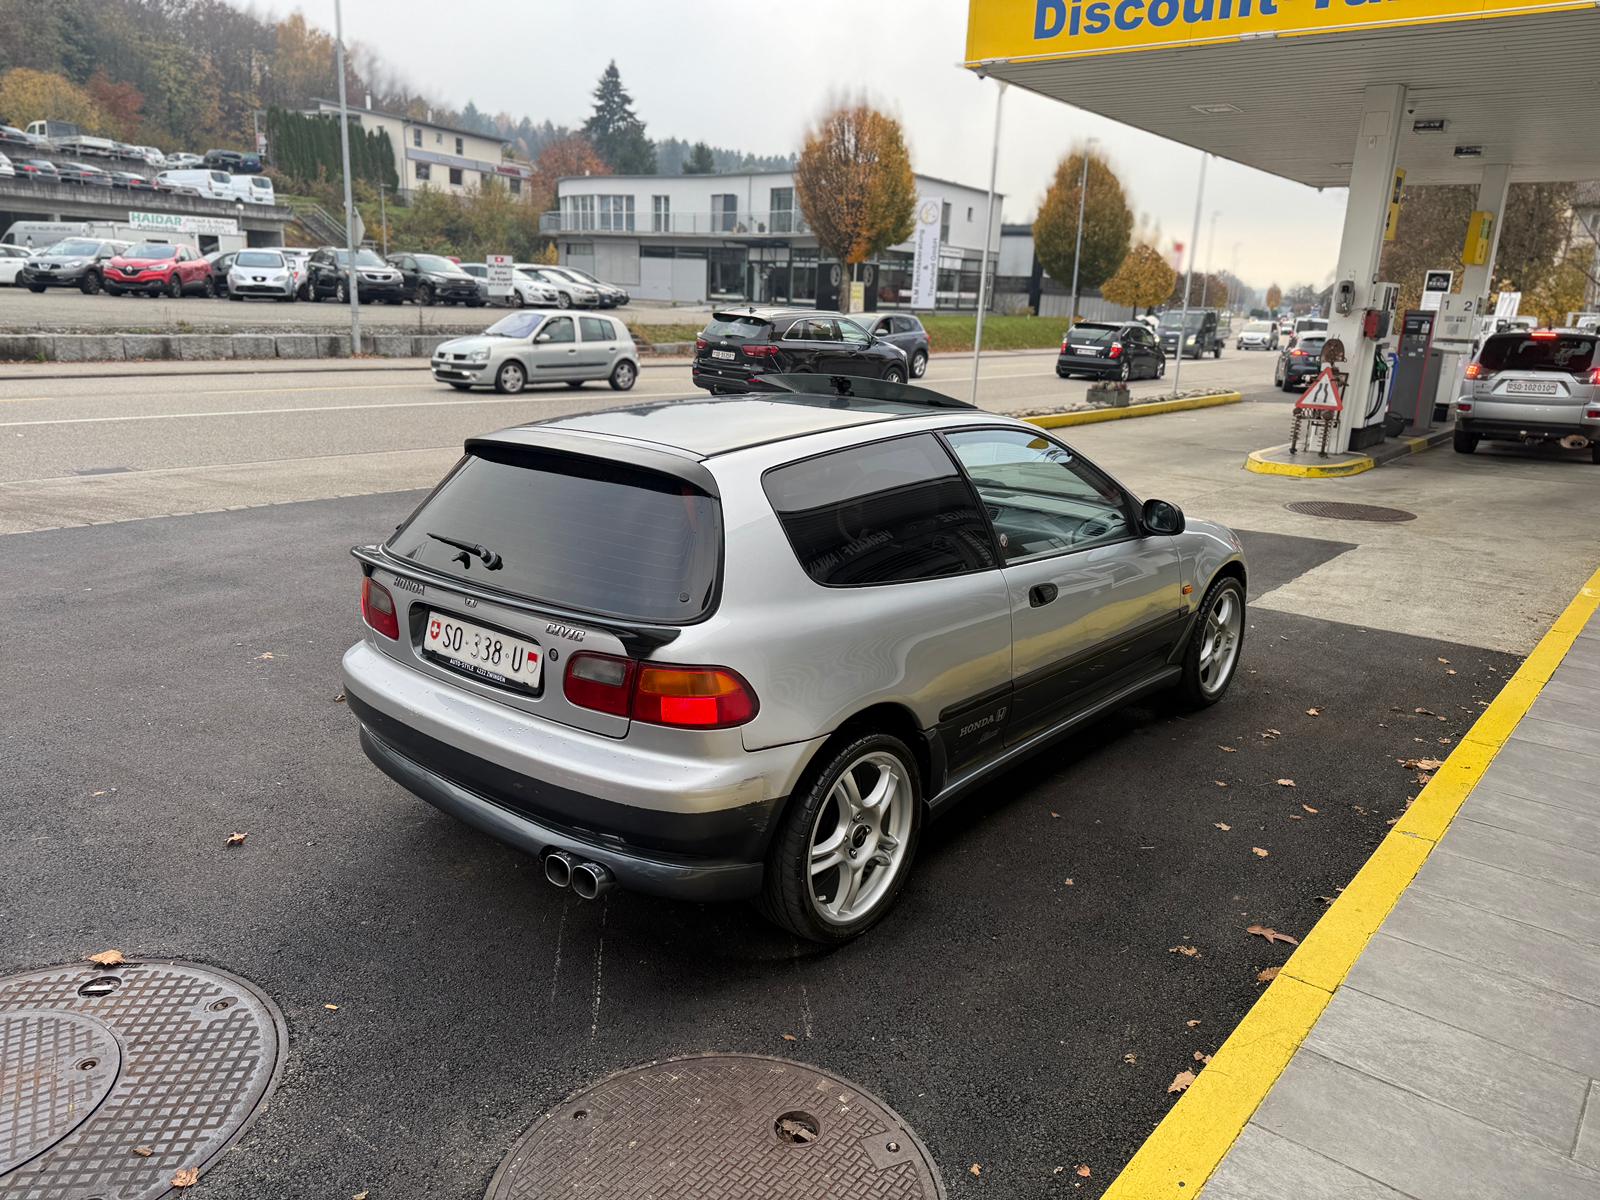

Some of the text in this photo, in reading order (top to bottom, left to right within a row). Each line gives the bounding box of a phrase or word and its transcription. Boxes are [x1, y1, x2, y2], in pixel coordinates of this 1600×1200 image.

[131, 212, 182, 226] HAIDAR
[1444, 300, 1450, 310] 1
[1463, 301, 1473, 311] 2
[393, 576, 426, 596] HONDA
[545, 623, 586, 643] CIVIC
[449, 659, 475, 671] AUTO-STYLE
[960, 715, 994, 737] HONDA
